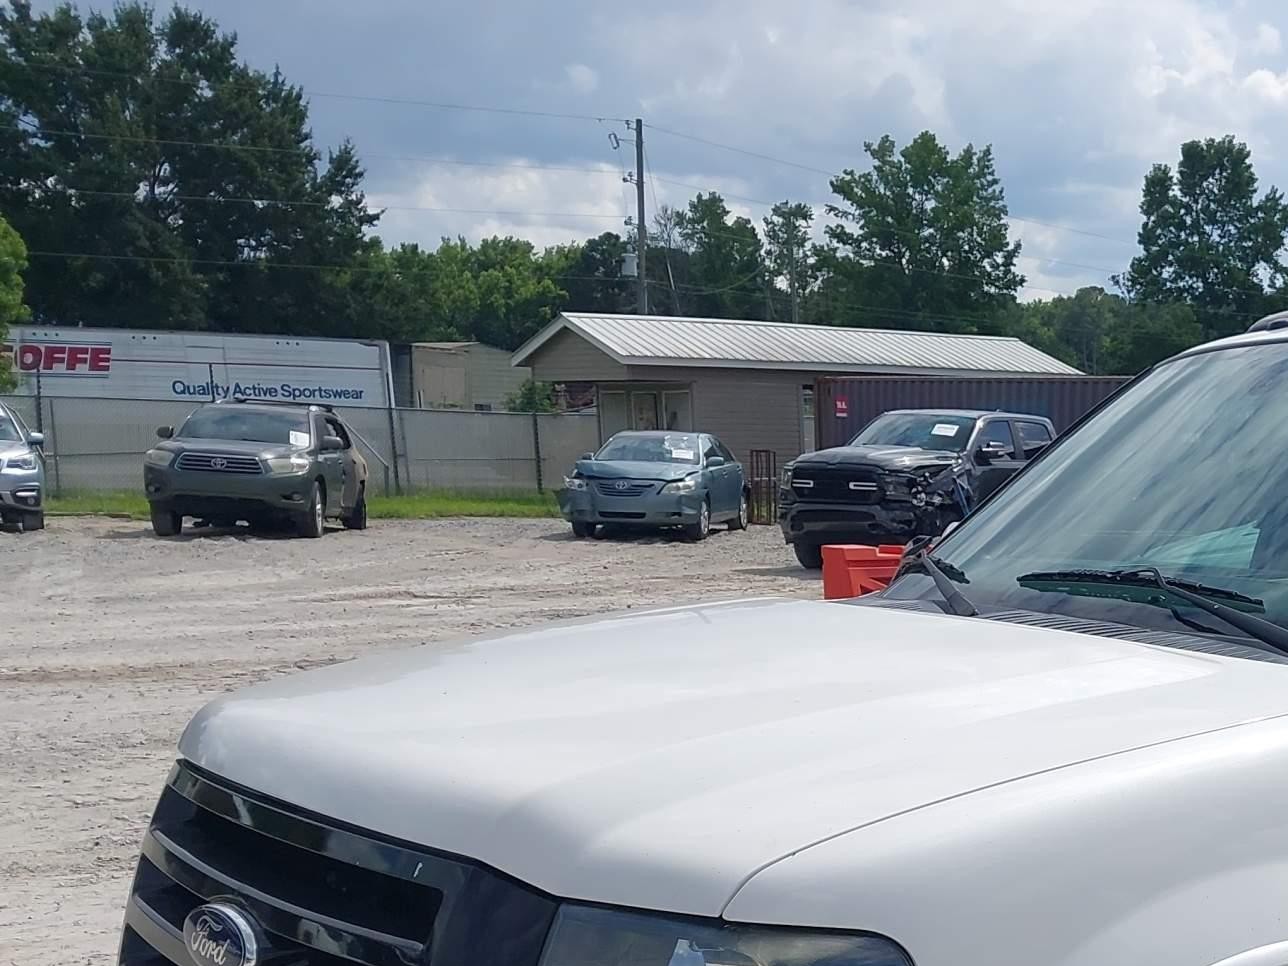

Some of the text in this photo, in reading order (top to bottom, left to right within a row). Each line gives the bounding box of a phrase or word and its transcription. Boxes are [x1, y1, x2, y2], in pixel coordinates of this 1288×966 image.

[0, 344, 112, 371] OFFE
[232, 382, 278, 398] Active
[280, 384, 364, 400] Sportswear
[191, 915, 230, 965] Ford
